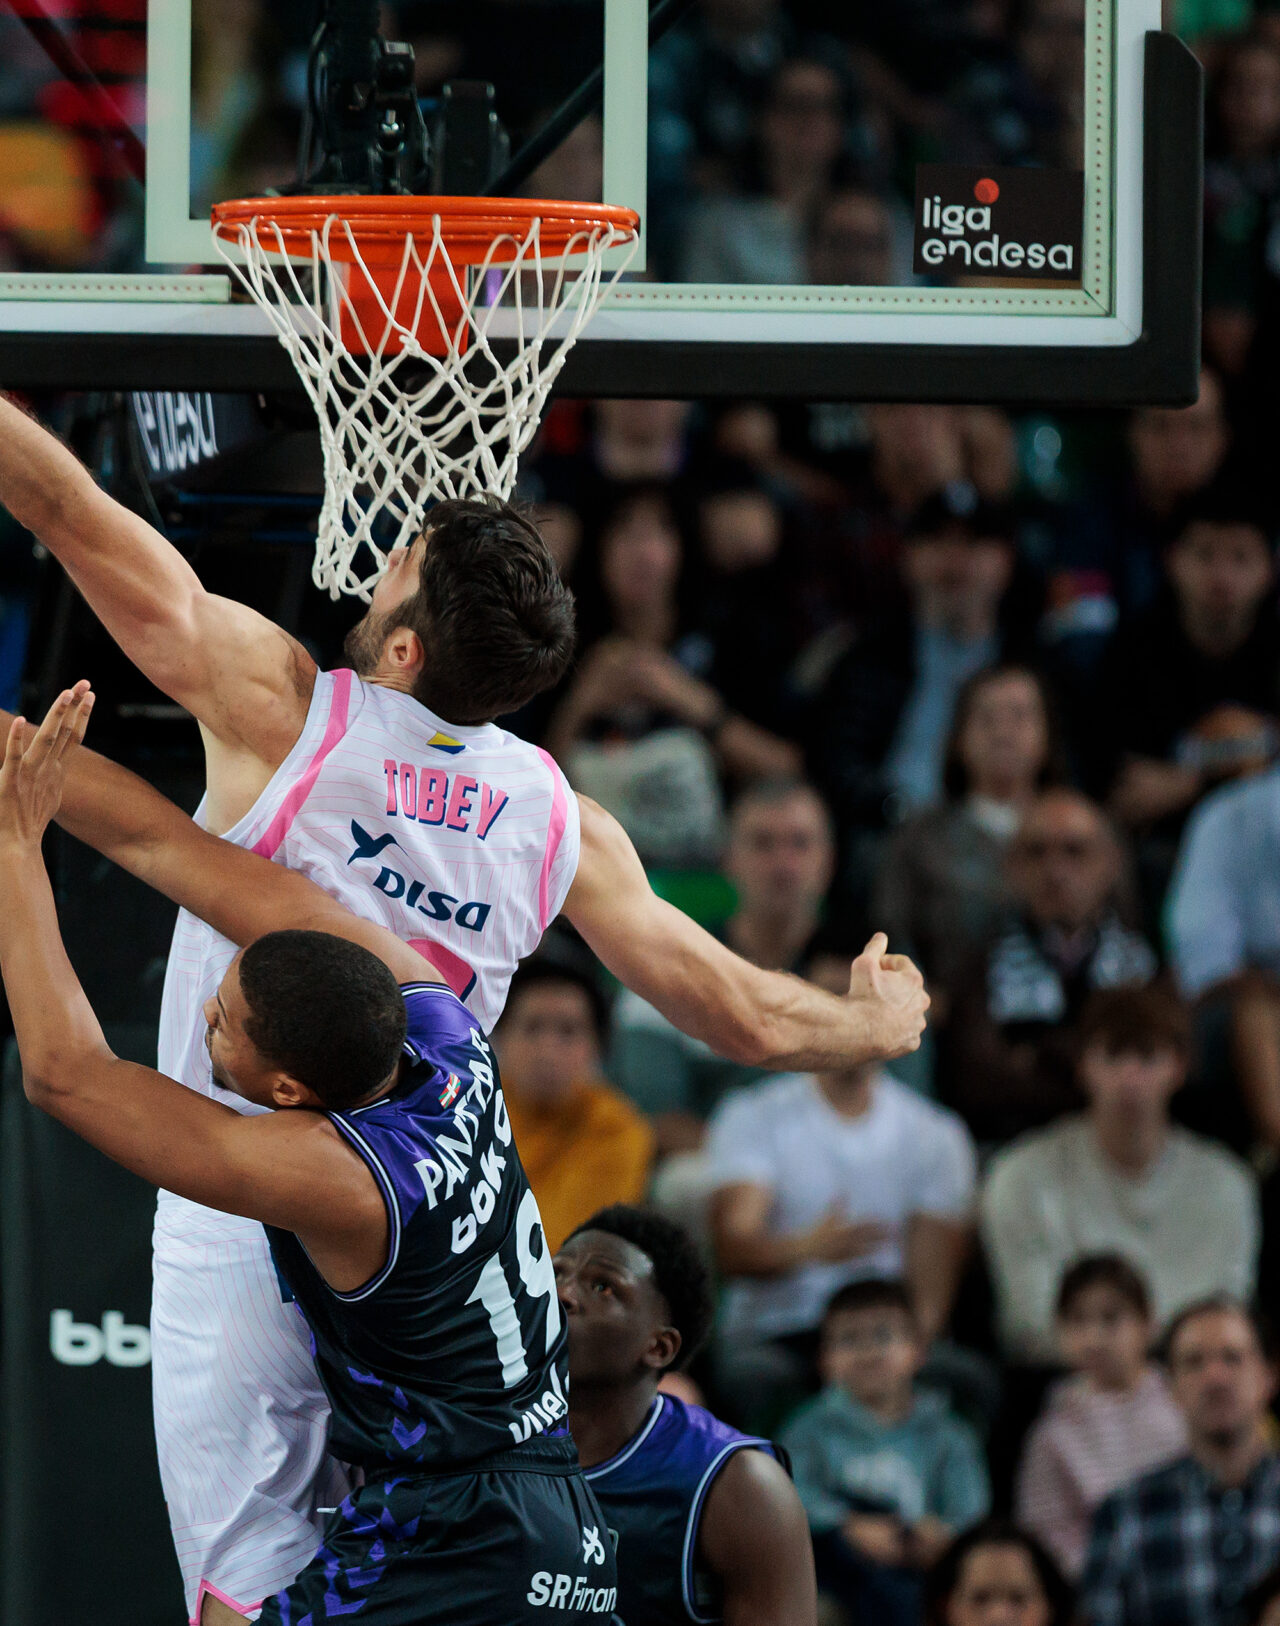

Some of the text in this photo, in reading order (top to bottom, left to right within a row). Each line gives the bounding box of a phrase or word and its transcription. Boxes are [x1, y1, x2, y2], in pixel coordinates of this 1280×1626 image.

[923, 195, 992, 236] liga
[922, 234, 1074, 270] endesa
[384, 759, 509, 841] TOBEY
[464, 1188, 562, 1389] 19
[508, 1362, 569, 1444] vuel
[527, 1571, 572, 1609] SR
